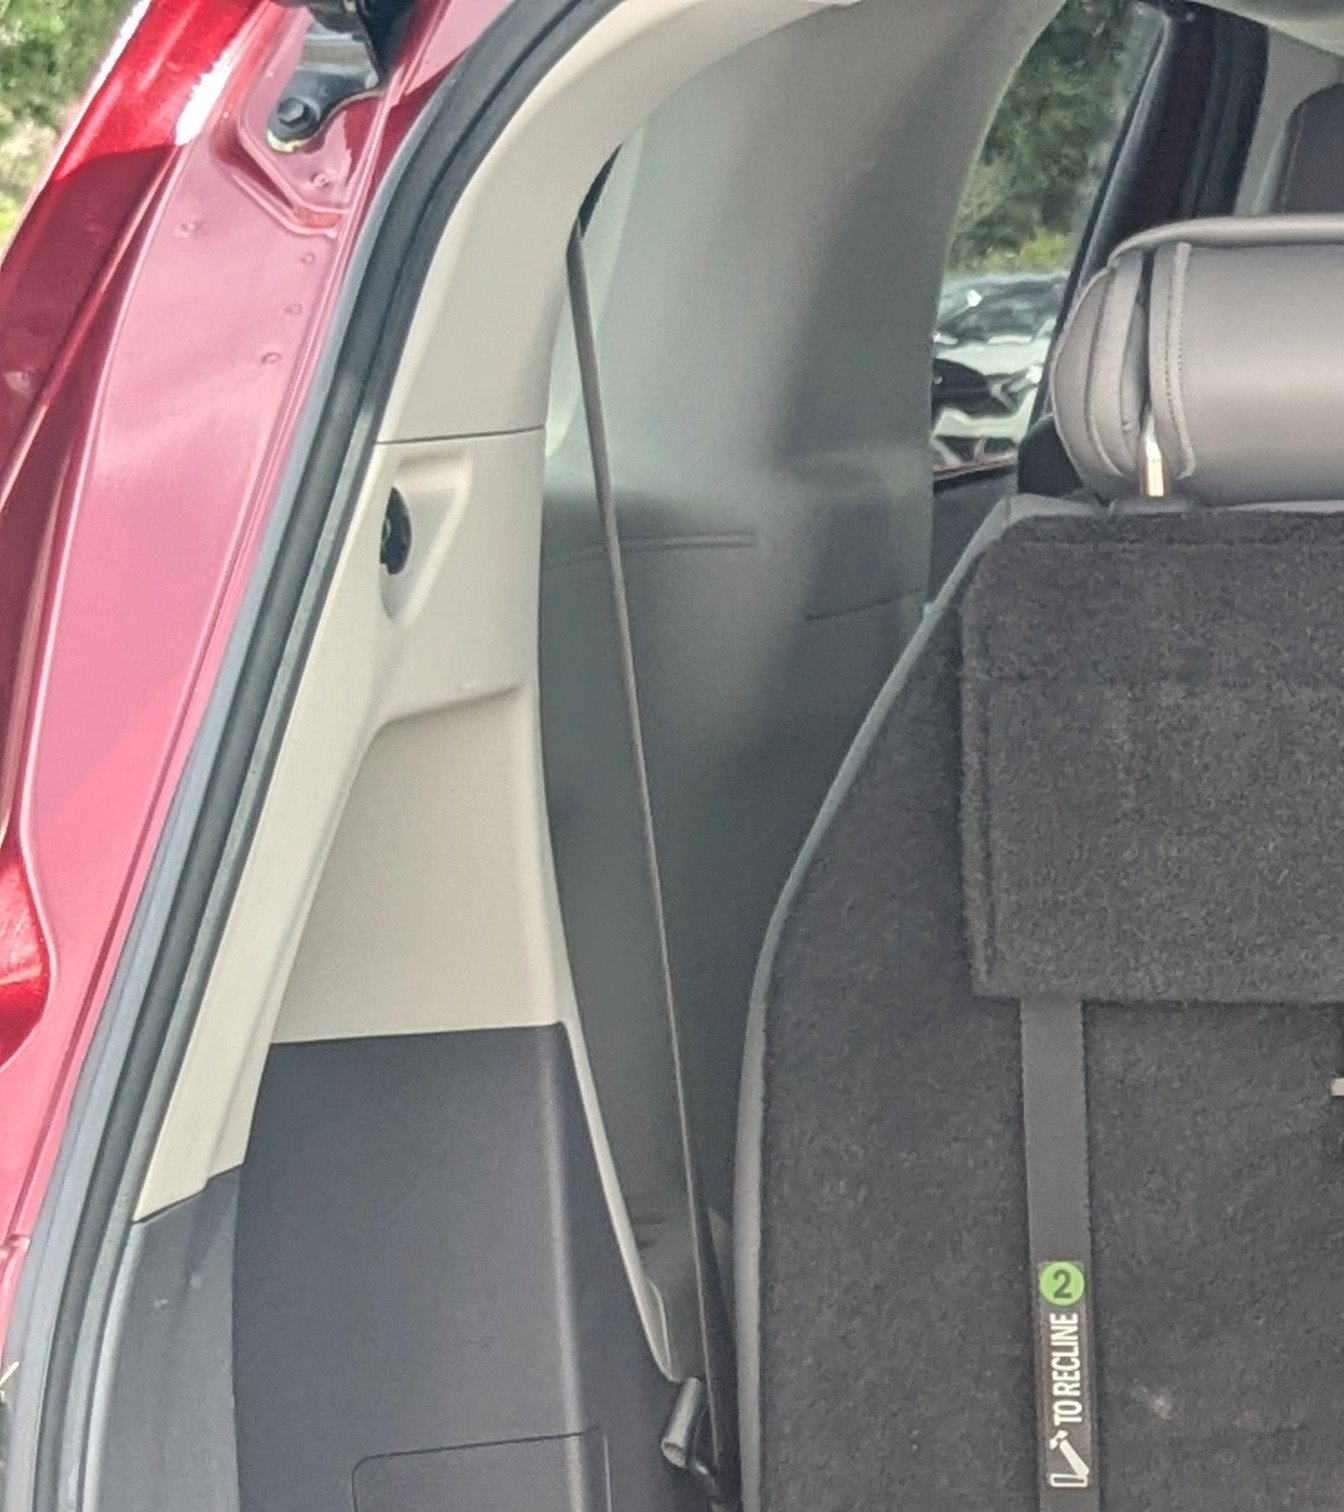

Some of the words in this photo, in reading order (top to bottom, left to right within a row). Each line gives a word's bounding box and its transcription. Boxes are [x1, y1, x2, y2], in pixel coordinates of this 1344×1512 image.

[1053, 1269, 1073, 1299] 2
[1050, 1312, 1081, 1397] RECLINE
[1052, 1400, 1083, 1426] TO
